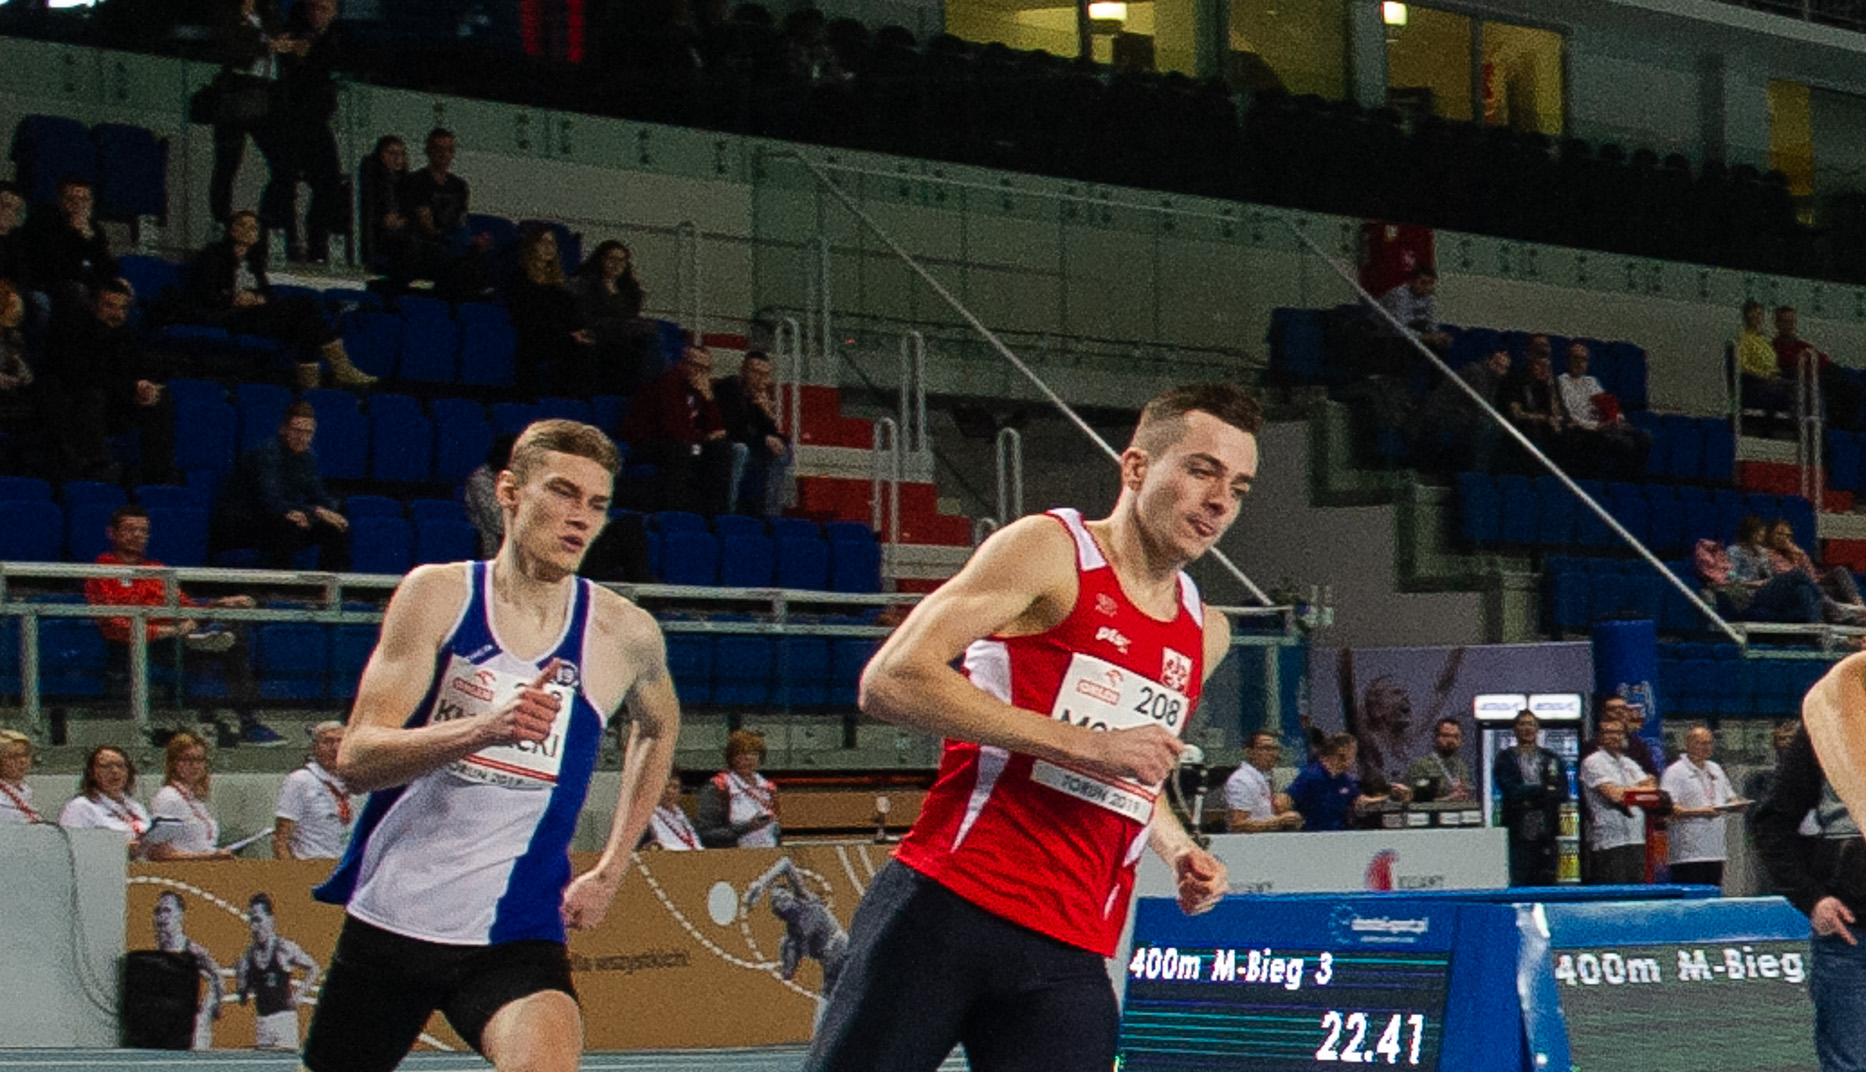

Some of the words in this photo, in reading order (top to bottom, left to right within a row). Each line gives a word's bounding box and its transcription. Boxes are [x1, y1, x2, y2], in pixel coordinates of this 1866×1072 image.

[1133, 686, 1181, 727] 208
[1129, 947, 1201, 979] 400m
[1211, 947, 1304, 990] M-Bieg
[1314, 951, 1334, 985] 3
[1554, 953, 1662, 986] 400m
[1677, 945, 1805, 984] M-Bieg
[1315, 1010, 1425, 1065] 22.41
